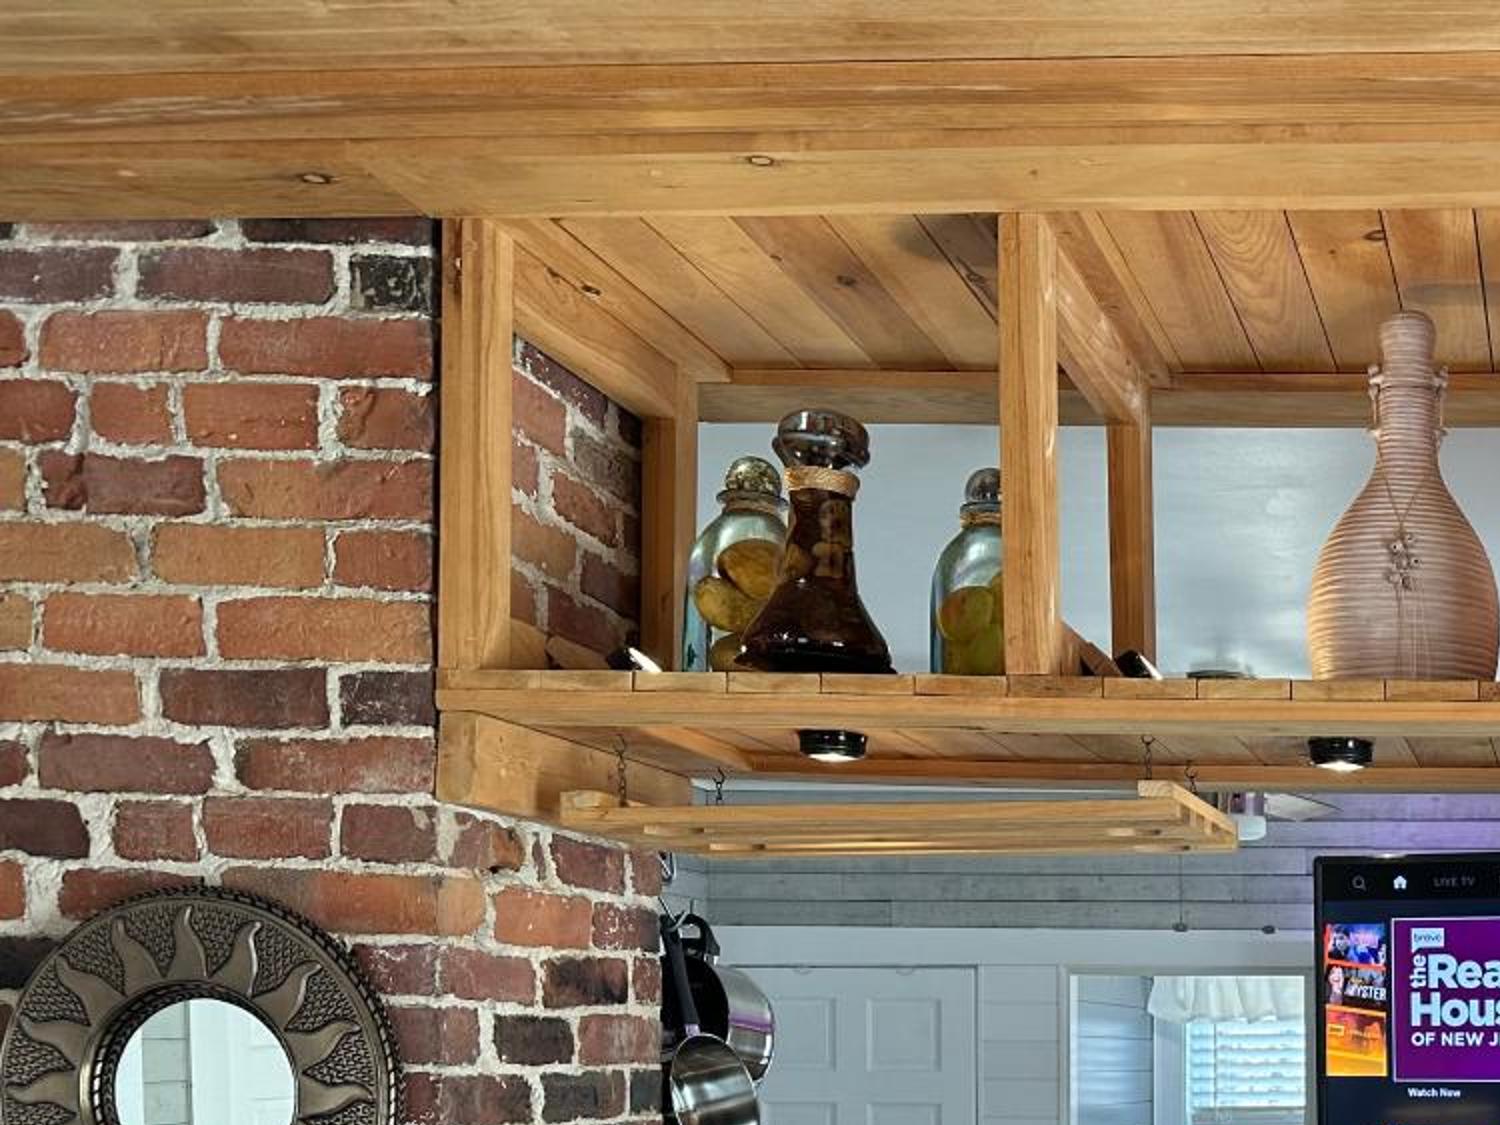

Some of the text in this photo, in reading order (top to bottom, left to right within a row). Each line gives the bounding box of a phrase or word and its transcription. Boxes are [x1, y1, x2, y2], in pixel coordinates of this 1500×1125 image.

[1461, 875, 1476, 886] TV
[1410, 955, 1427, 987] the
[1411, 1032, 1436, 1047] OF
[1440, 1031, 1485, 1047] NEW
[1408, 1087, 1437, 1098] Watch
